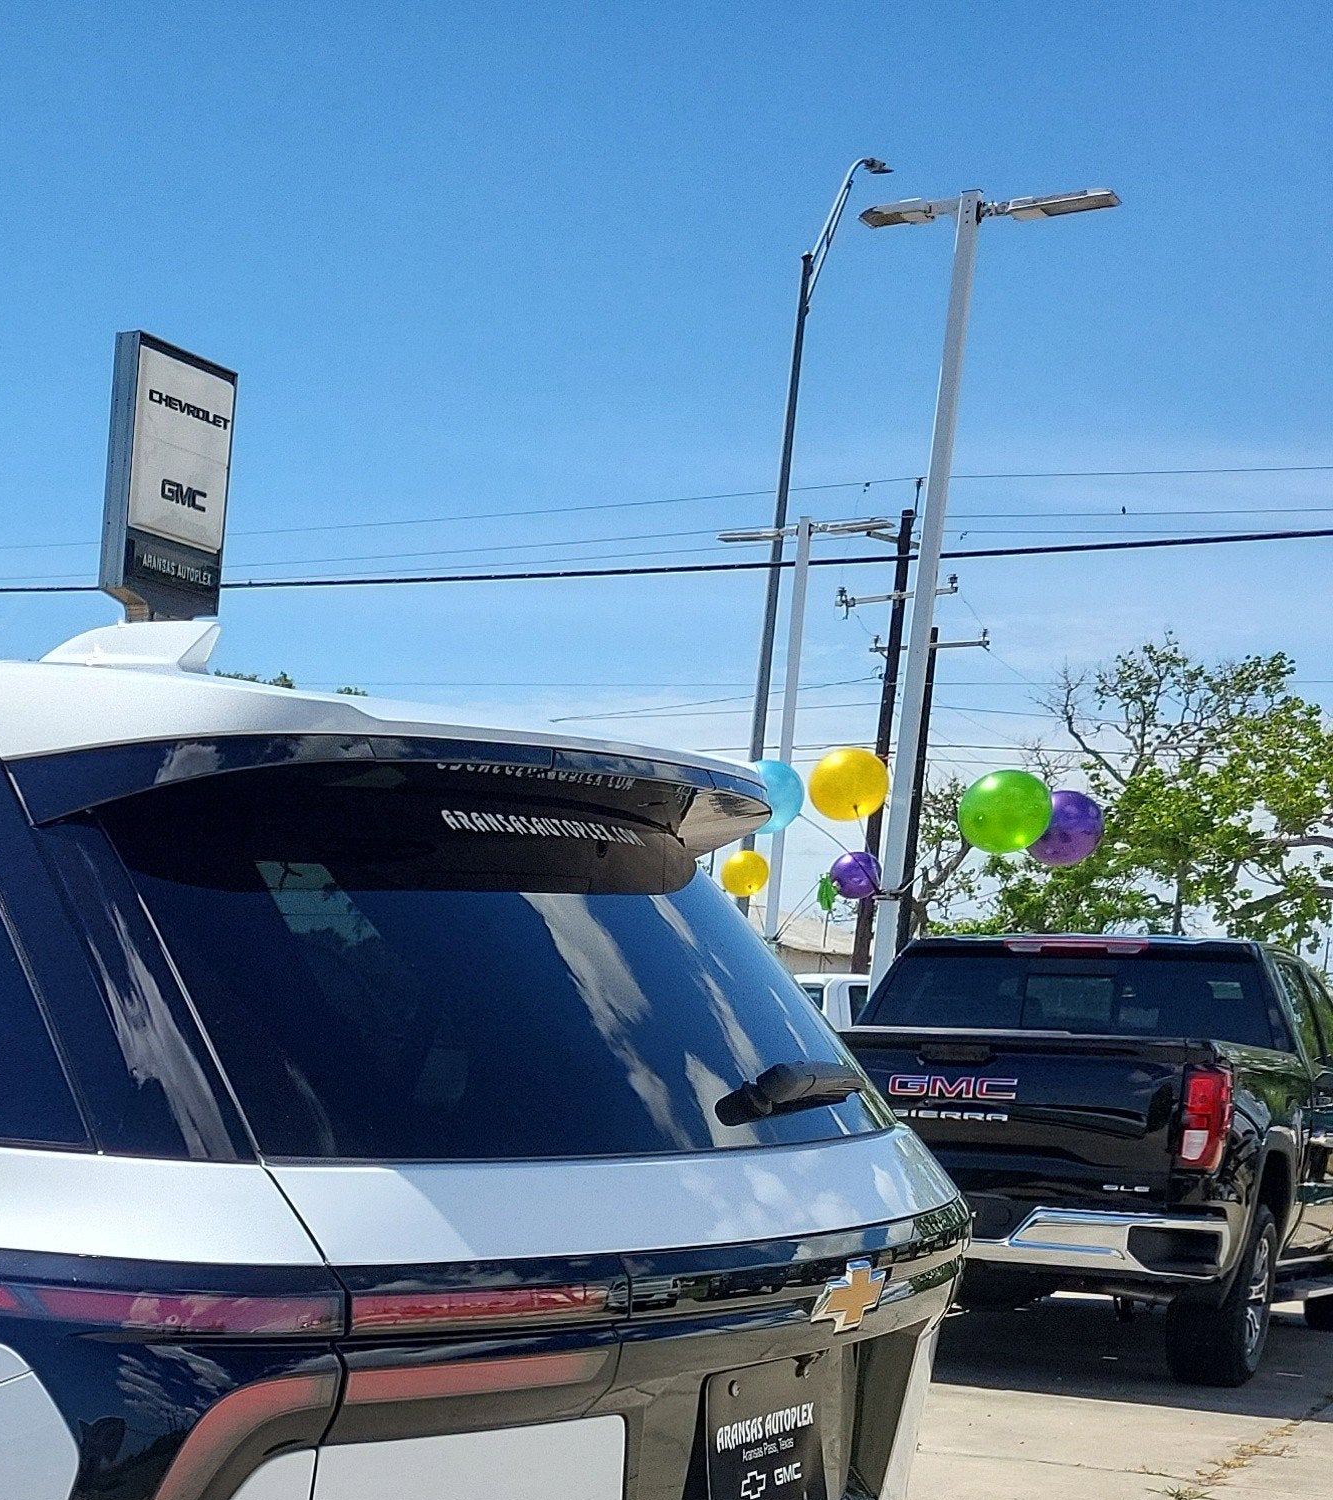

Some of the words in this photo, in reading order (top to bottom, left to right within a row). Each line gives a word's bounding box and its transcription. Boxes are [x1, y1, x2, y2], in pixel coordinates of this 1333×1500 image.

[148, 388, 231, 431] CHEVROLET
[160, 478, 208, 513] GMC
[888, 1074, 1018, 1100] GMC
[892, 1108, 1009, 1122] SIERRA
[716, 1416, 764, 1454] ARANSAS
[764, 1402, 814, 1439] AUTOPLEX
[773, 1461, 802, 1486] GMC
